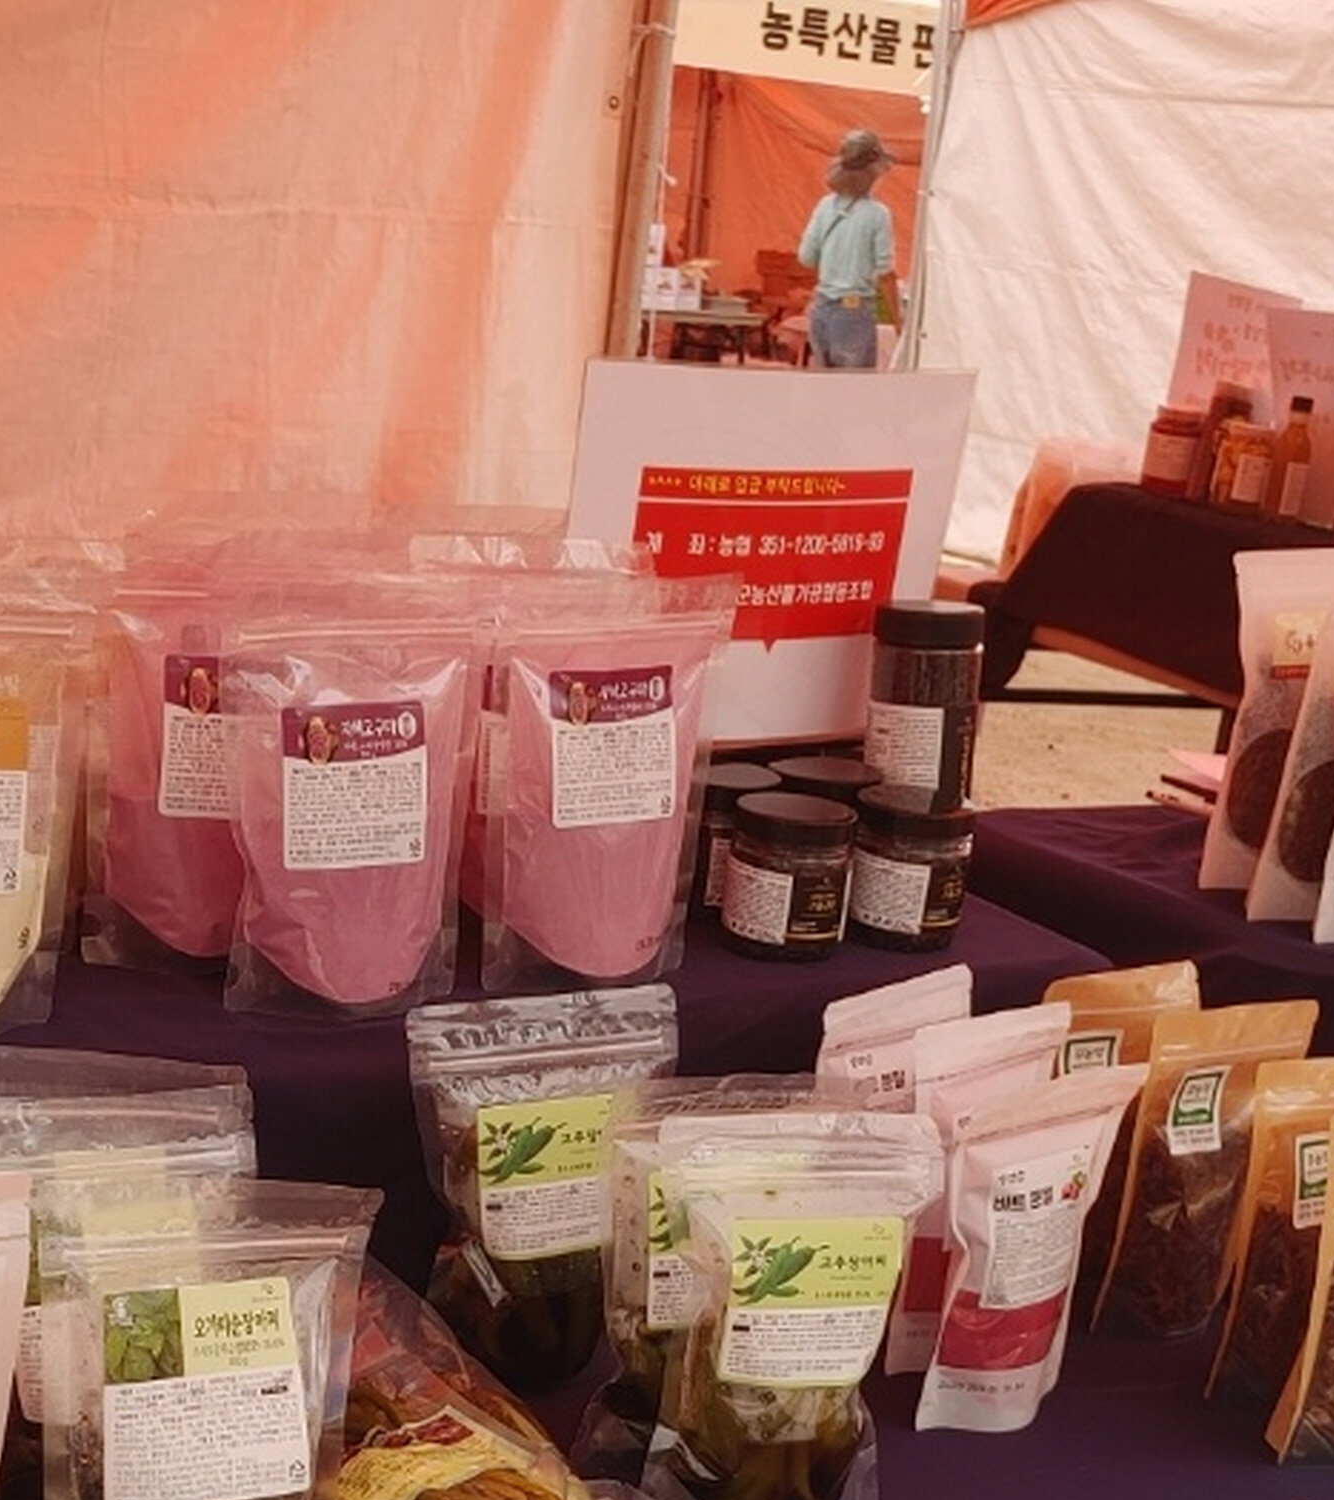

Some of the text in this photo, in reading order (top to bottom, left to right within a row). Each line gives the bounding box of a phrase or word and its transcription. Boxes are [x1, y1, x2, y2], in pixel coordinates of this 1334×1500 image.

[761, 2, 901, 66] 농특산물
[718, 534, 752, 557] 농협
[993, 1193, 1026, 1212] 비트
